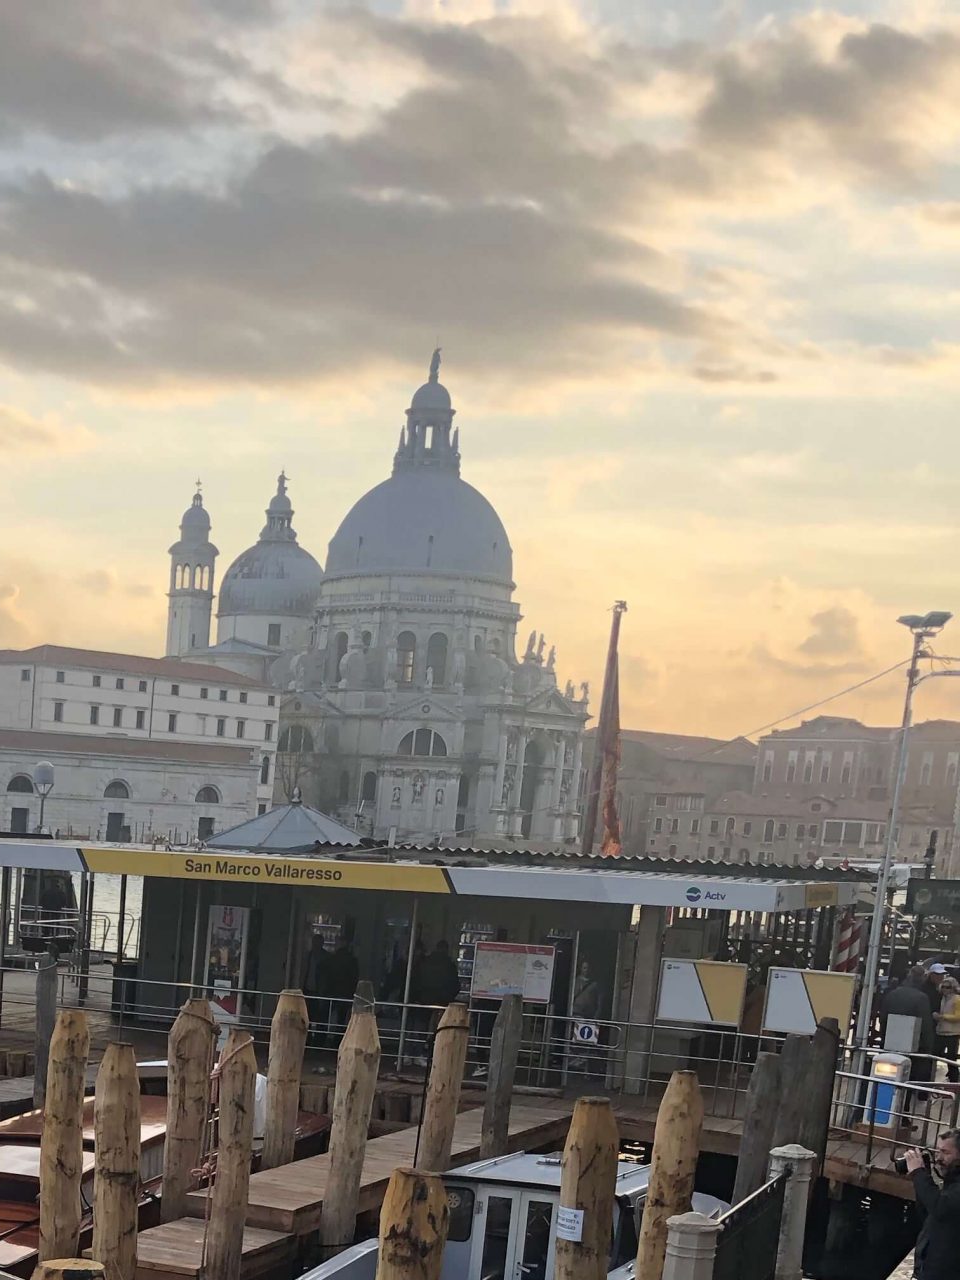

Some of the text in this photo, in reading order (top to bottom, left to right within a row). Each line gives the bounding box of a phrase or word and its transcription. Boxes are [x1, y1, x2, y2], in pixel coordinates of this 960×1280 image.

[185, 859, 342, 880] San Marco Vallaresso
[704, 891, 726, 900] Actv
